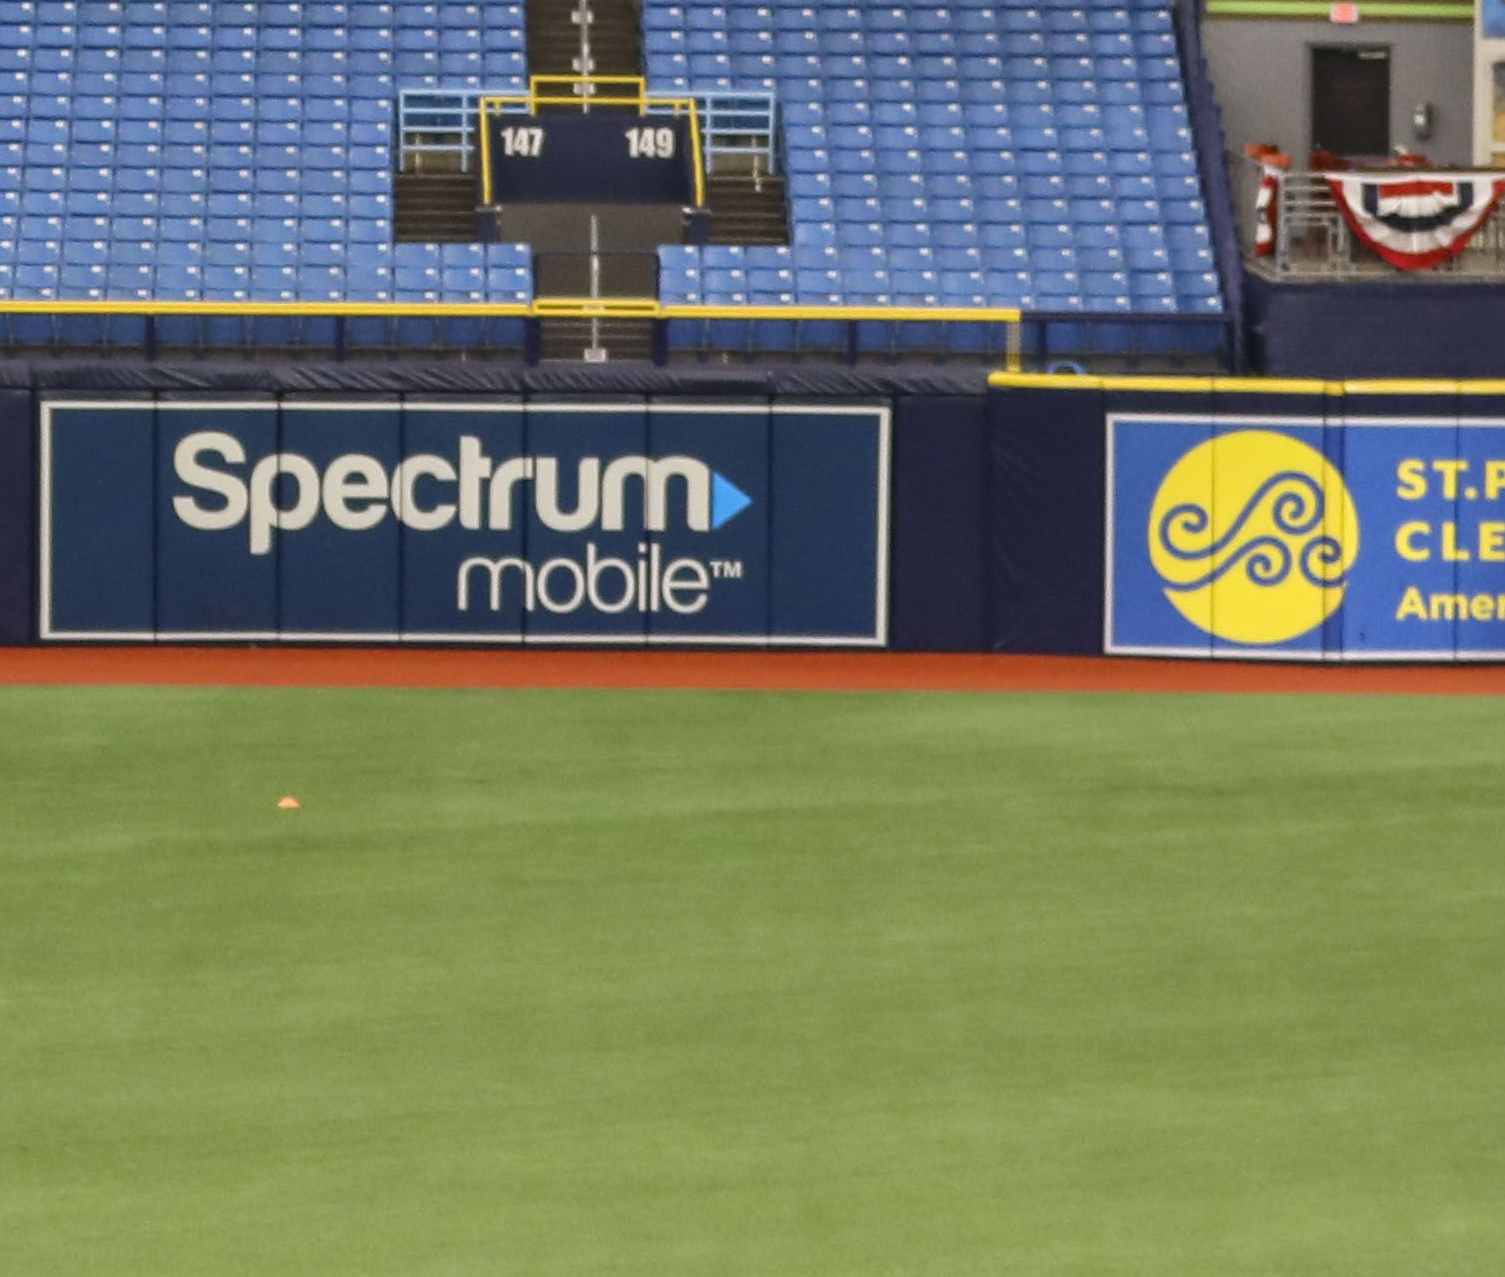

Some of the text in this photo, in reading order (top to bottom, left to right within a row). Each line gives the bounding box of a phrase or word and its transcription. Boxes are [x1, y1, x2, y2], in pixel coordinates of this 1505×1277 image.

[500, 127, 543, 157] 147
[626, 128, 674, 158] 149
[173, 431, 710, 555] Spectrum
